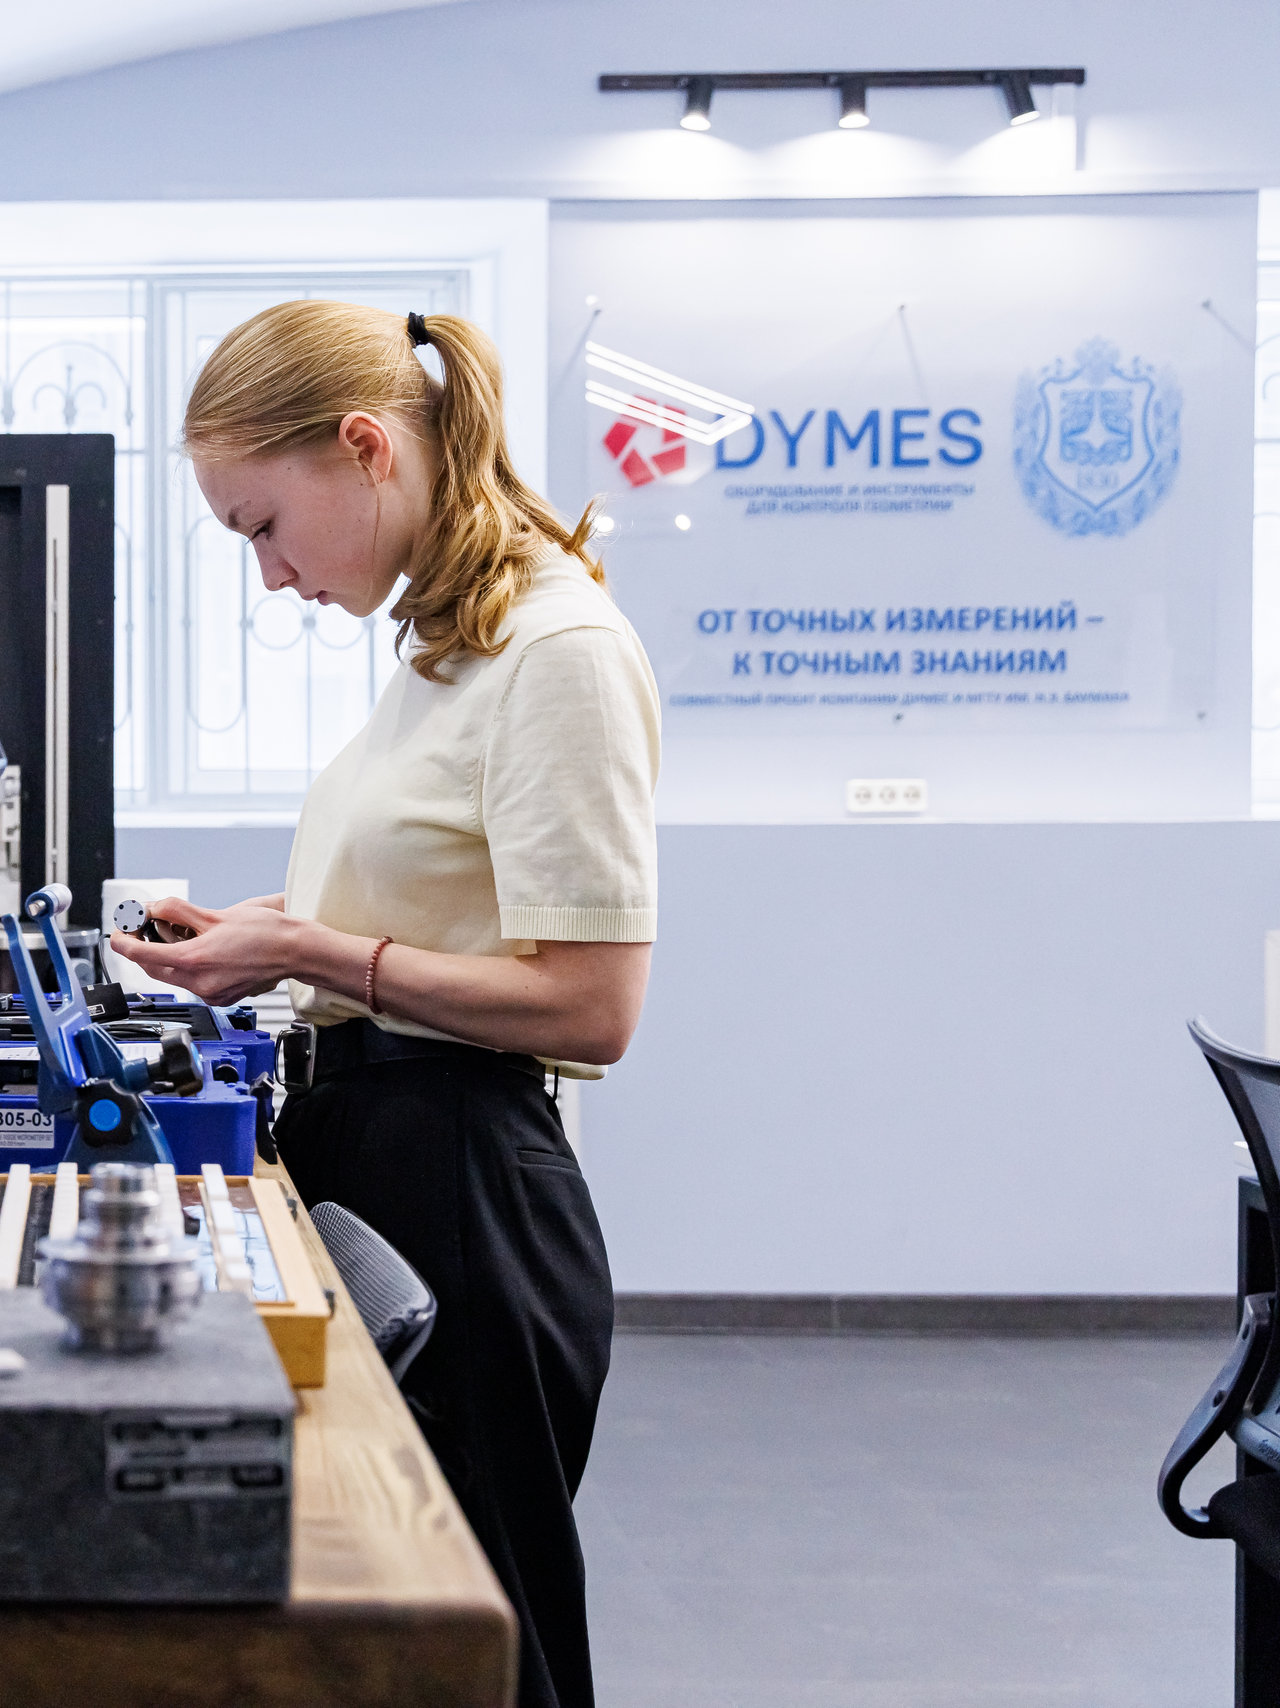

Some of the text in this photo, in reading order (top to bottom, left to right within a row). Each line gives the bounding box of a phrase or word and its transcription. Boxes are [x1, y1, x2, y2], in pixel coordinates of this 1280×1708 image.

[715, 408, 984, 469] DYMES
[697, 608, 736, 633] ОТ
[748, 608, 876, 633] ТОЧНЫХ
[886, 600, 1077, 632] ИЗМЕРЕНИЙ
[732, 649, 1068, 676] К ТОЧНЫМ ЗНАНИЯМ
